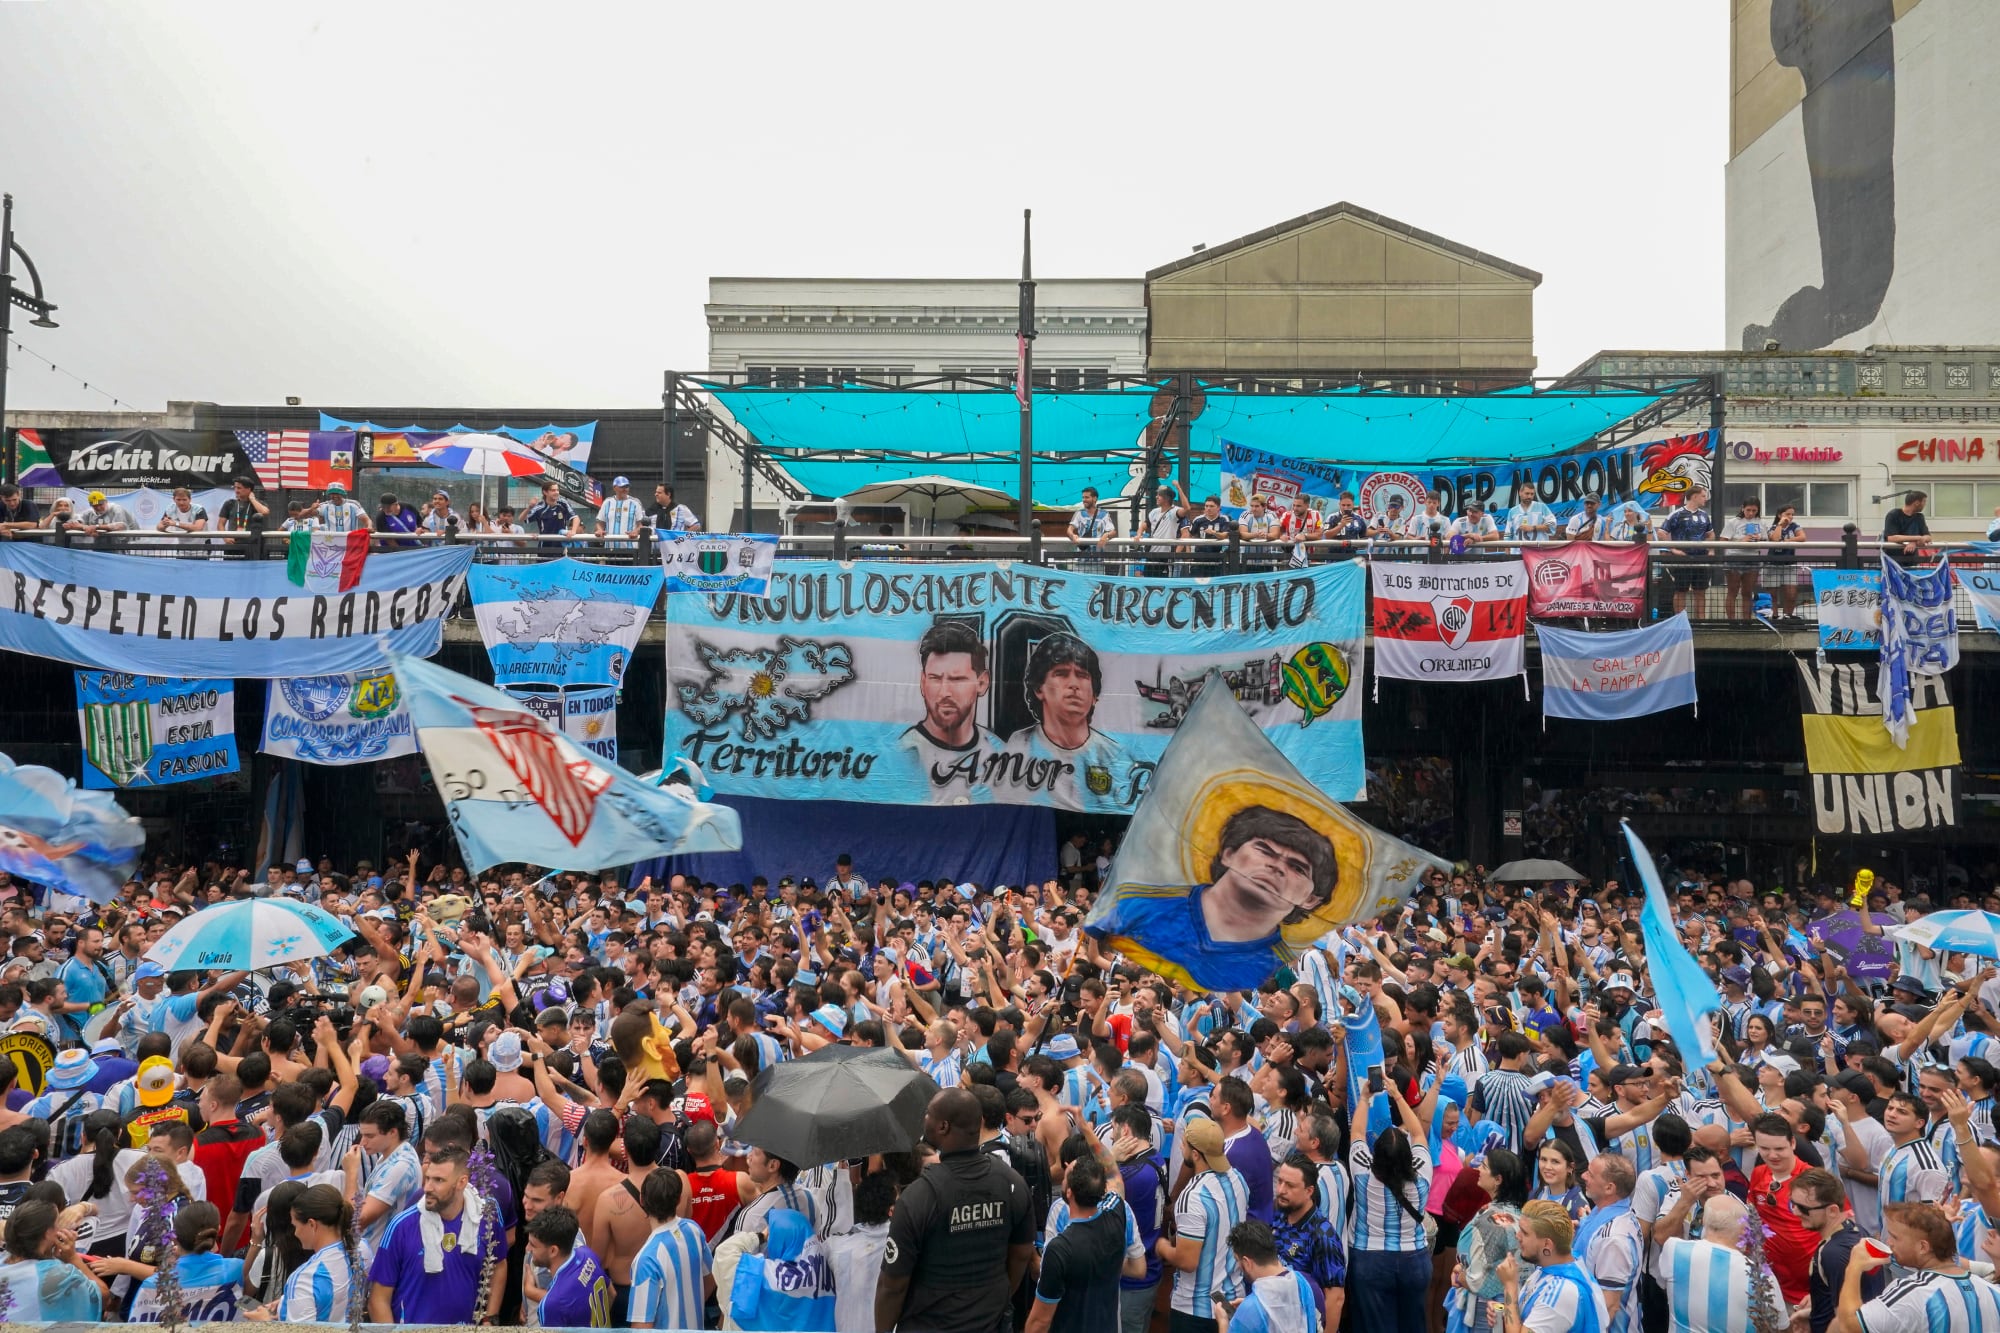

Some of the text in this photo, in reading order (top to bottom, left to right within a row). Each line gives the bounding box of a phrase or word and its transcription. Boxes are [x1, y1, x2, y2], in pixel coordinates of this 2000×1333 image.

[67, 446, 235, 473] Kickit Kourt
[1754, 447, 1774, 465] by
[1791, 446, 1844, 462] Mobile
[1896, 436, 1985, 463] CHINA
[1227, 444, 1345, 484] QUE LA CUENTEN
[1432, 449, 1635, 516] DEP. MORON
[1362, 473, 1426, 520] CLUB DEPORTIVO
[676, 553, 683, 563] &
[572, 569, 653, 586] LAS MALVINAS
[687, 577, 696, 587] DE
[697, 580, 723, 589] DONDE
[725, 572, 749, 588] VENGO
[13, 570, 457, 642] RESPETEN LOS RANGOS
[709, 567, 1316, 633] ORGULLOSAMENTE ARGENTINO
[1582, 602, 1590, 611] DE
[1592, 601, 1613, 611] NEW
[1614, 602, 1634, 613] YORK
[1820, 589, 1843, 607] DE
[1487, 601, 1516, 633] 14
[1825, 628, 1856, 646] AL
[509, 662, 568, 677] ARGENTINAS
[1592, 651, 1662, 673] GRAL PICO
[78, 673, 88, 690] Y
[100, 671, 136, 690] POR
[359, 679, 391, 708] AFA
[1572, 674, 1647, 693] LA PAMPA
[159, 689, 219, 717] NACIO
[327, 686, 350, 714] ESTADO
[568, 694, 614, 714] EN TODOS
[166, 719, 214, 746] ESTA
[270, 711, 345, 742] COMODORO
[158, 749, 229, 779] PASION
[681, 728, 879, 779] Territorio
[931, 749, 1075, 791] Amor
[1813, 768, 1955, 834] UNION
[1616, 973, 1628, 982] 10
[950, 1201, 1004, 1225] AGENT
